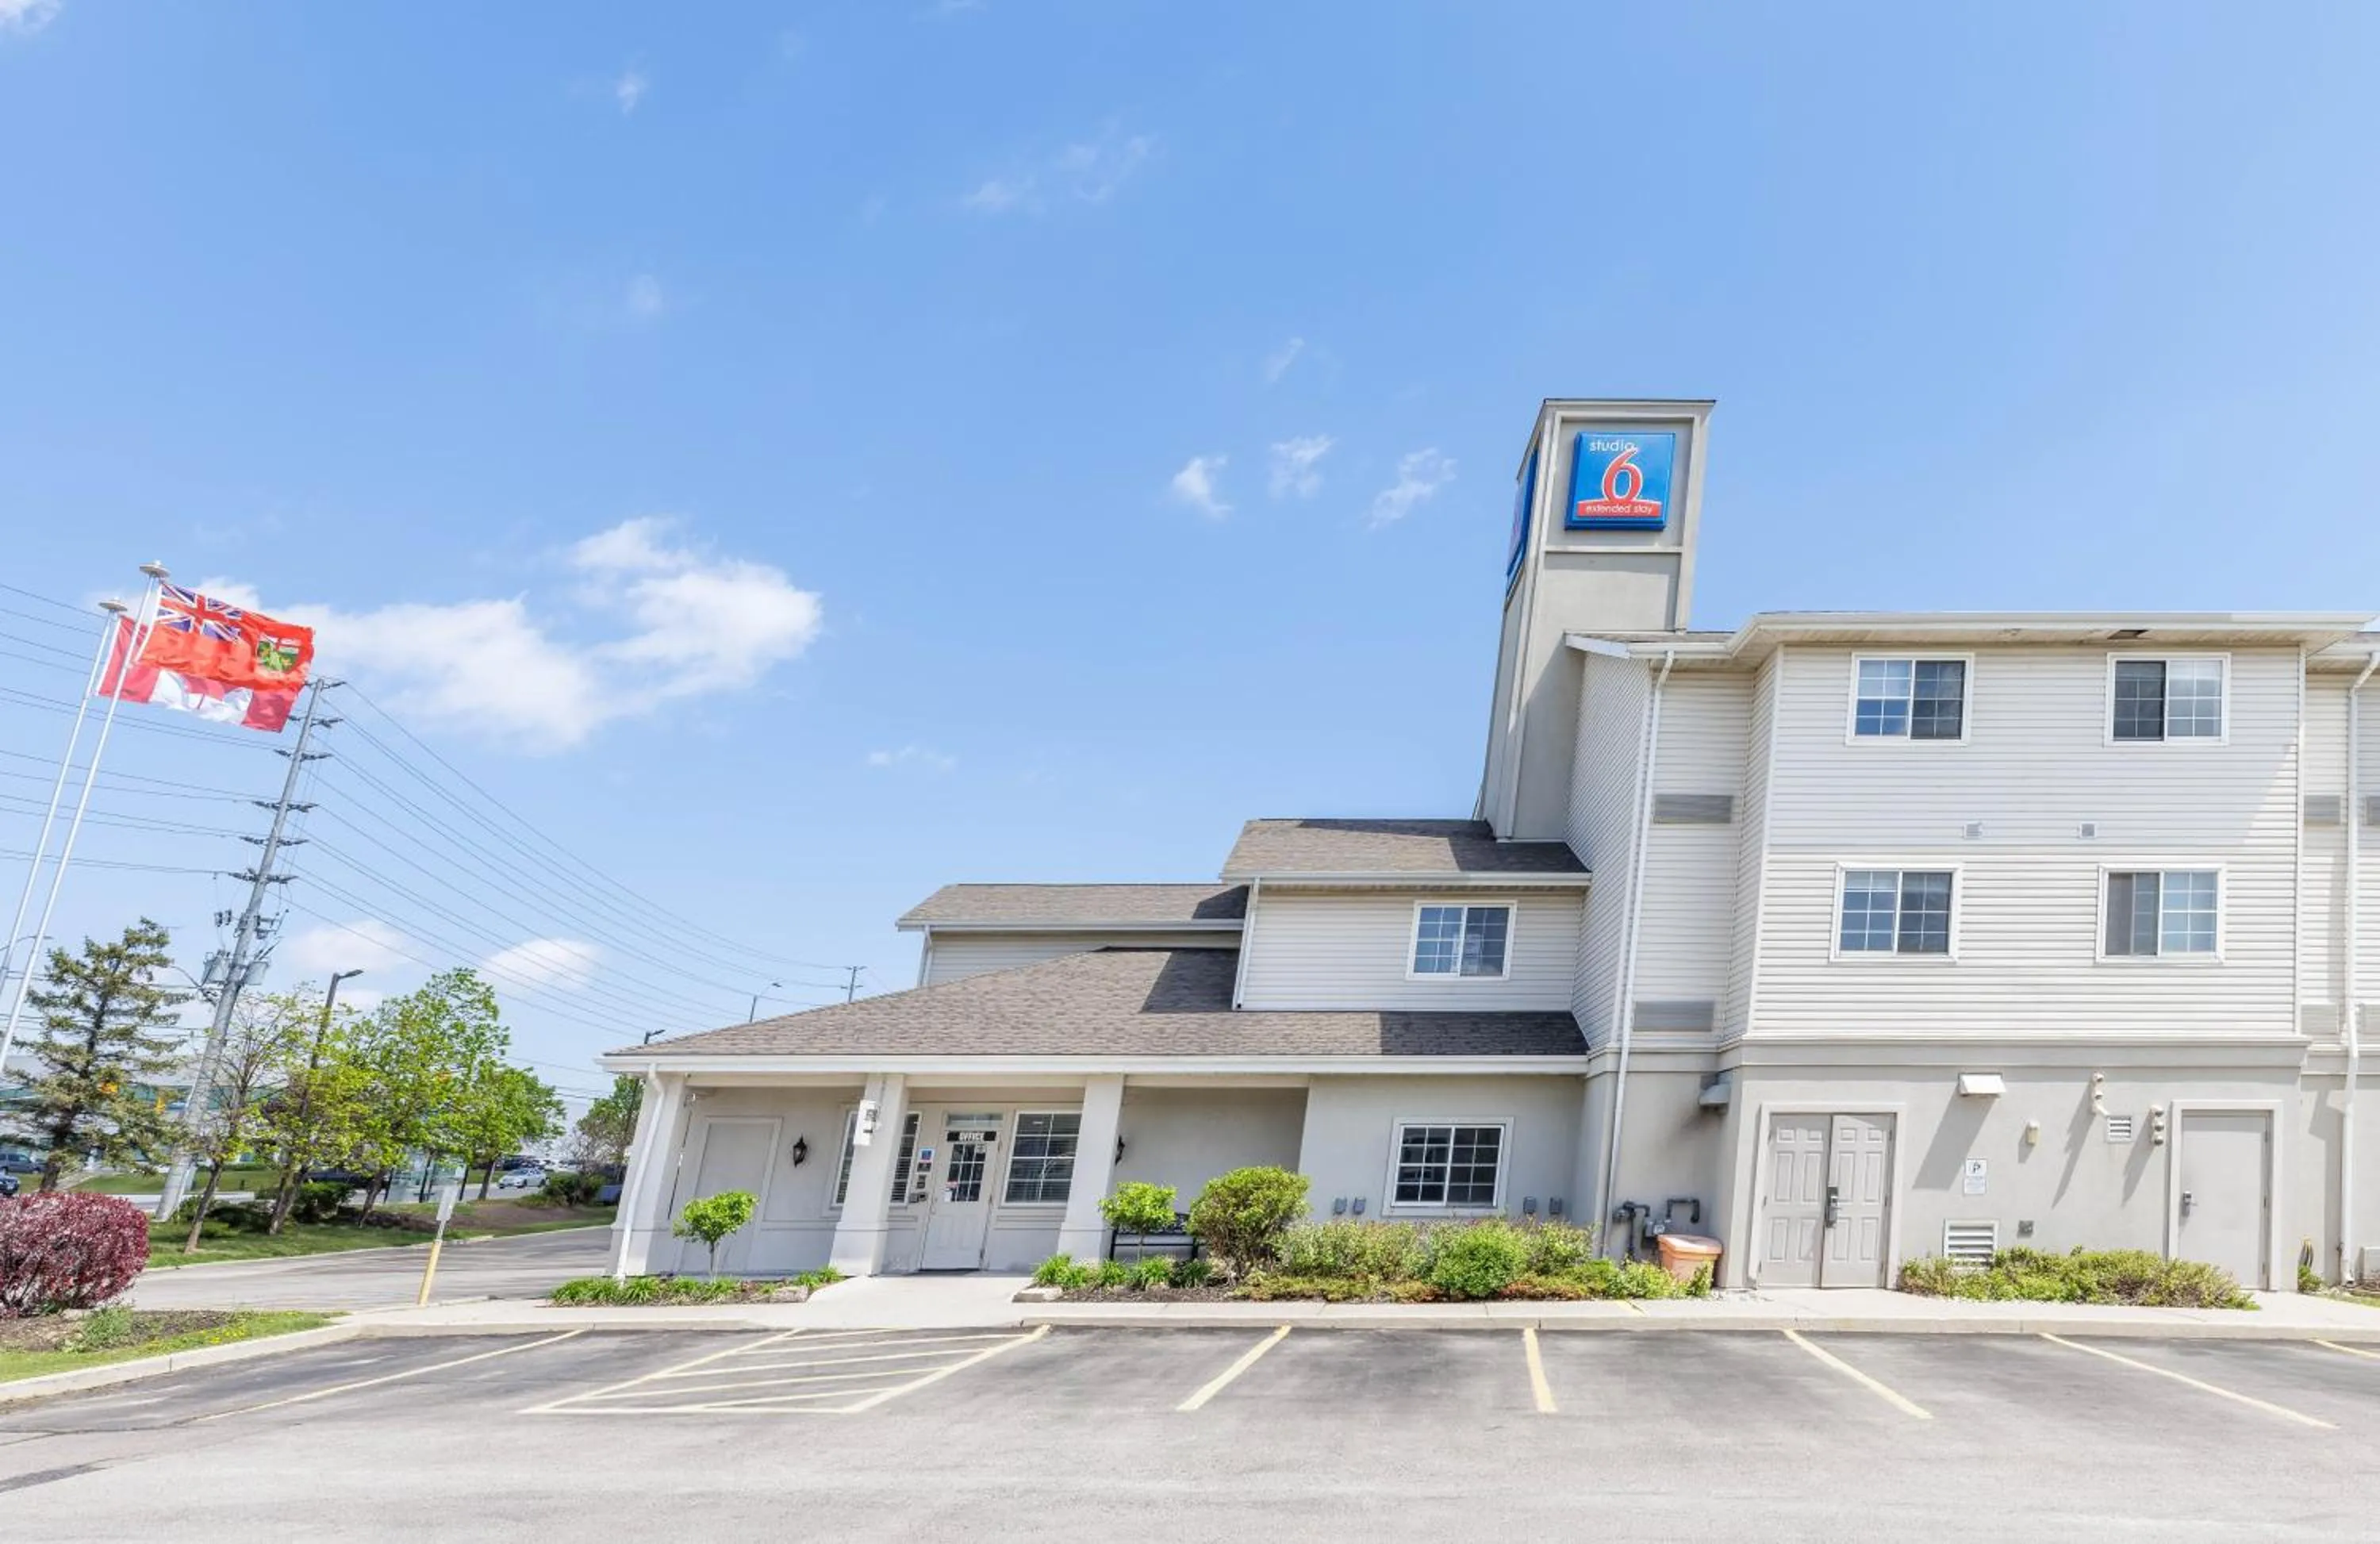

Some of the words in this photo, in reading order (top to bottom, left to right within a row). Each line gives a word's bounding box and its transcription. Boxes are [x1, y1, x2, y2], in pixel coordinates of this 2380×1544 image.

[1589, 438, 1635, 451] studio
[1602, 447, 1643, 503] 6
[1586, 504, 1631, 513] extended
[1633, 503, 1653, 515] stay
